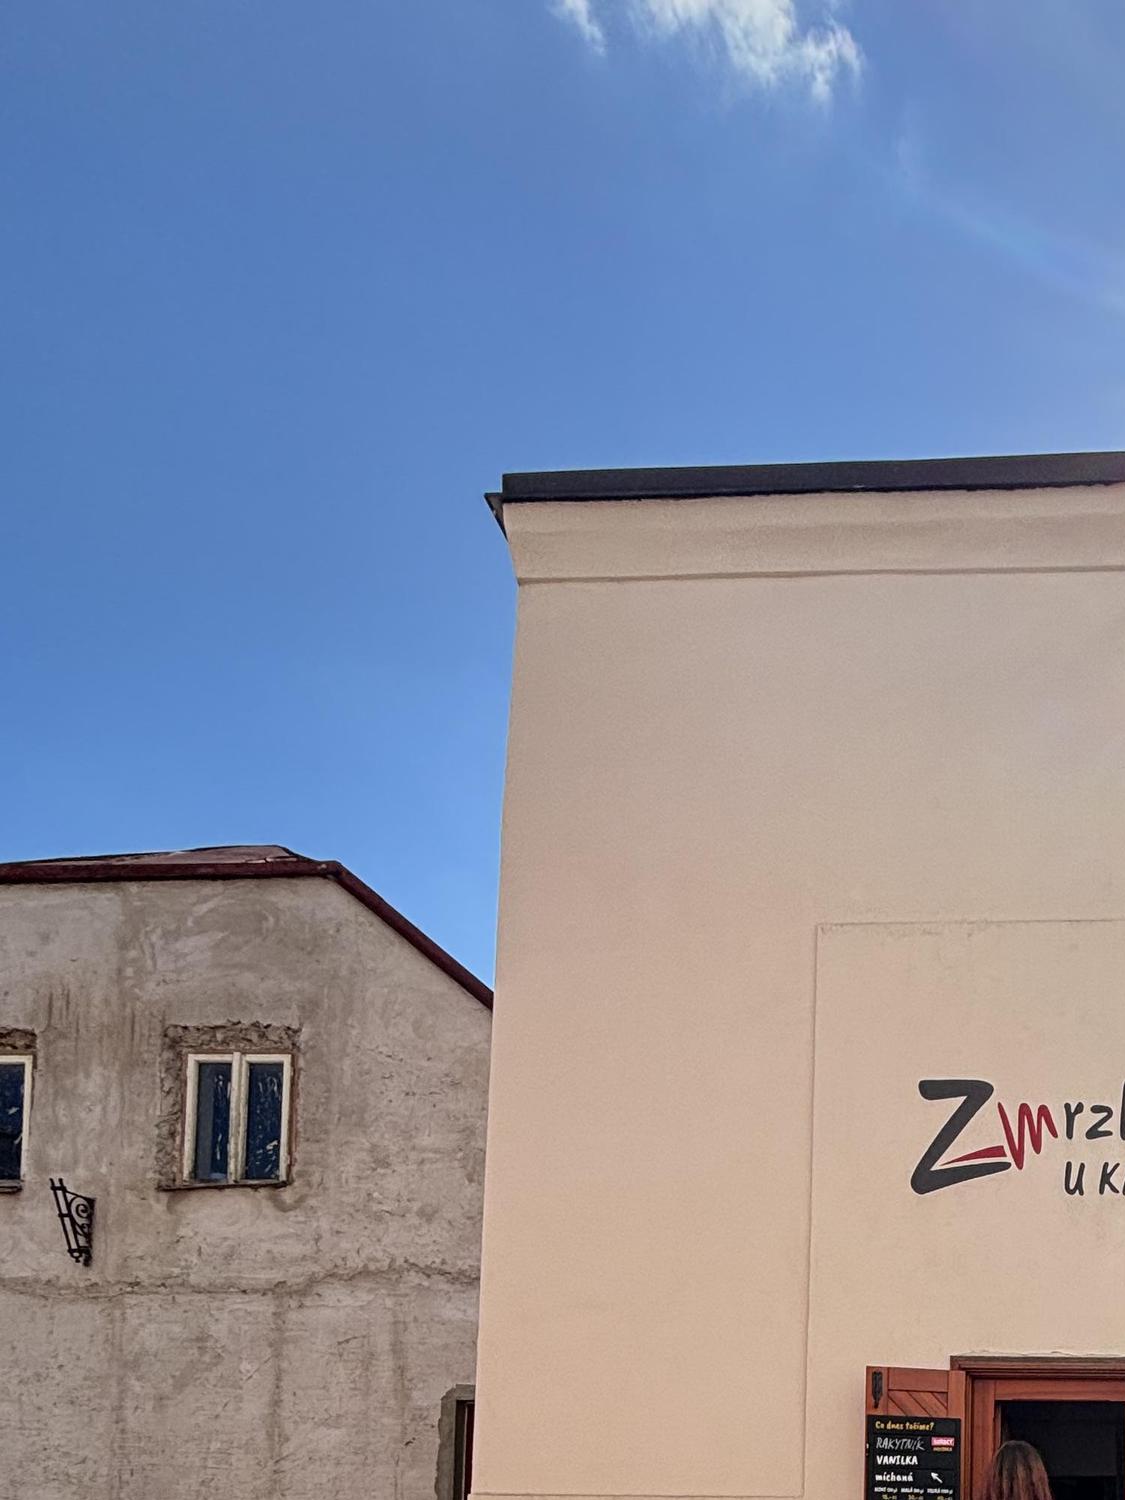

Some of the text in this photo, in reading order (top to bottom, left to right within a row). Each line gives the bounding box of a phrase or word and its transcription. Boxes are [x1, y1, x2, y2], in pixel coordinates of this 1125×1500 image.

[875, 1421, 885, 1430] Co
[886, 1421, 904, 1430] dnes
[876, 1437, 925, 1451] RAKYTNÍK
[876, 1455, 918, 1465] VANILKA
[875, 1472, 914, 1482] míchaná
